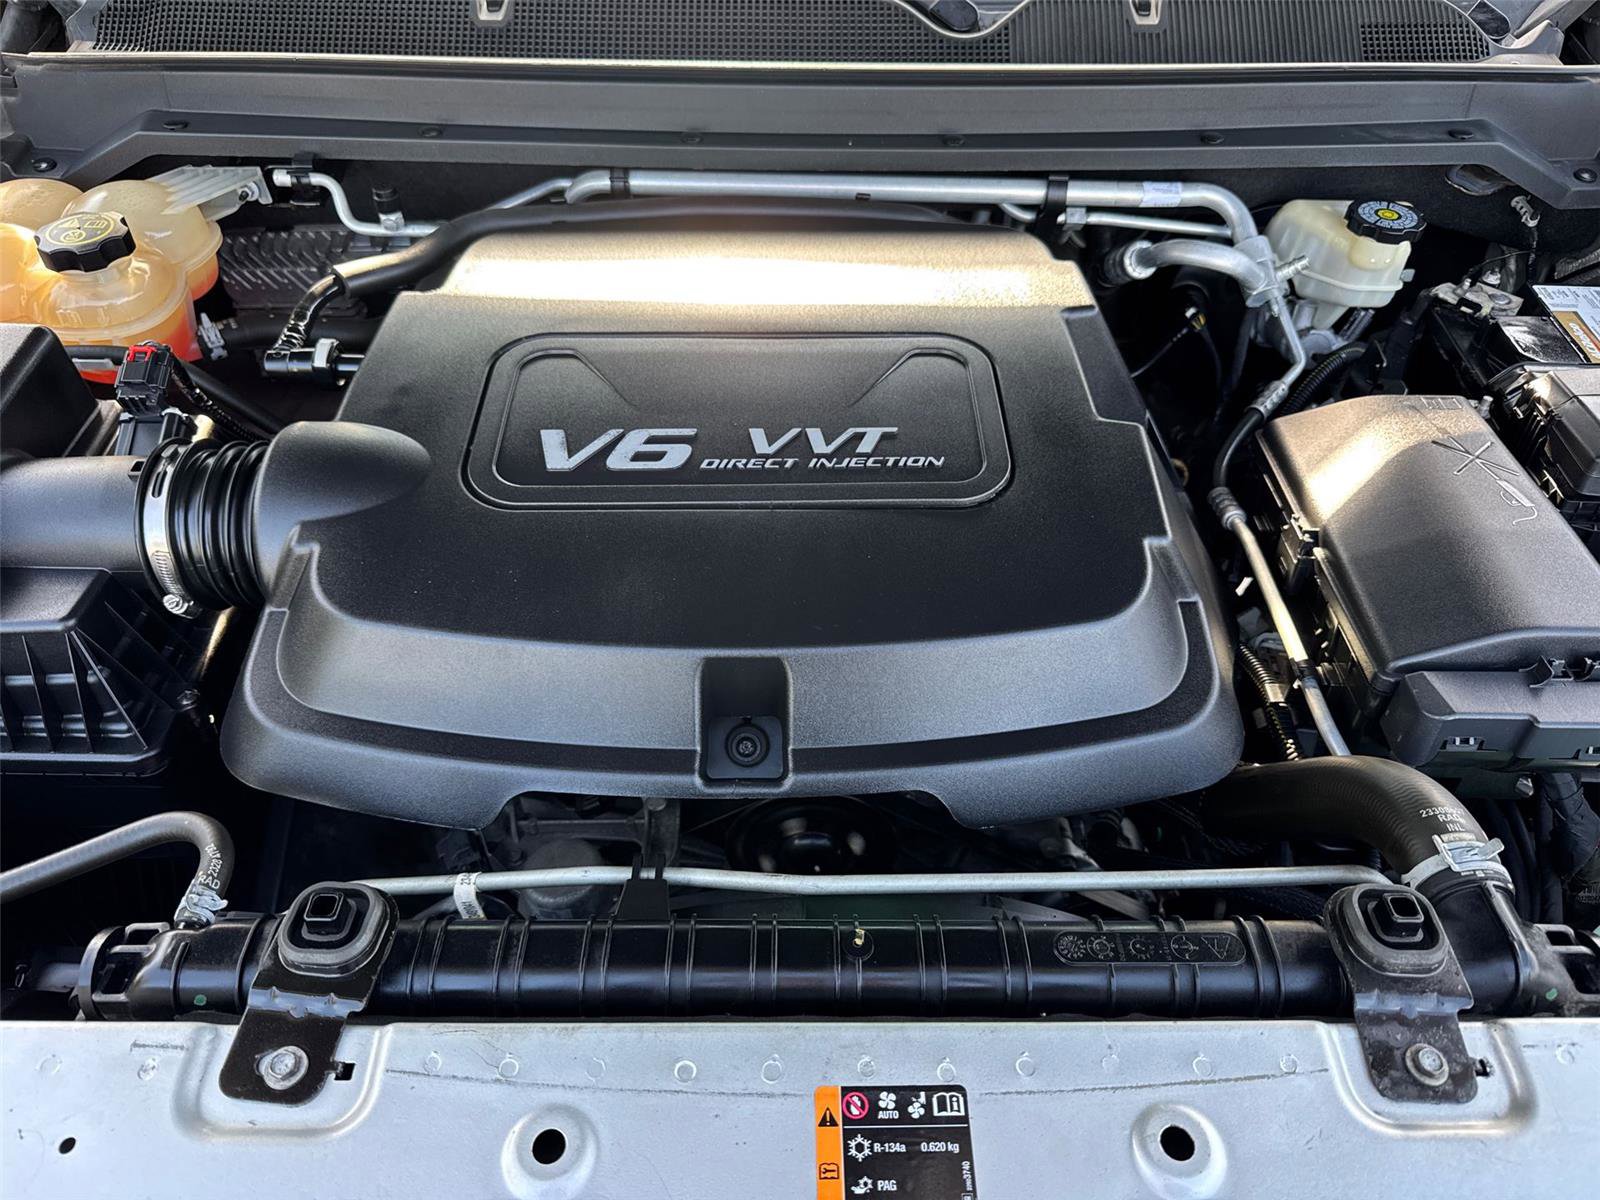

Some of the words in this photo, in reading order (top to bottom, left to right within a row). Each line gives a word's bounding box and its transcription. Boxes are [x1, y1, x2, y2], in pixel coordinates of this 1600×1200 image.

[539, 428, 698, 472] V6
[748, 426, 899, 456] VVT
[699, 457, 799, 471] DIRECT
[808, 455, 946, 470] INJECTION
[198, 875, 220, 889] RAD
[878, 1110, 899, 1119] AUTO
[874, 1142, 906, 1152] R-134a
[921, 1141, 946, 1152] 0.620
[947, 1141, 960, 1154] kg
[877, 1180, 897, 1191] PAG
